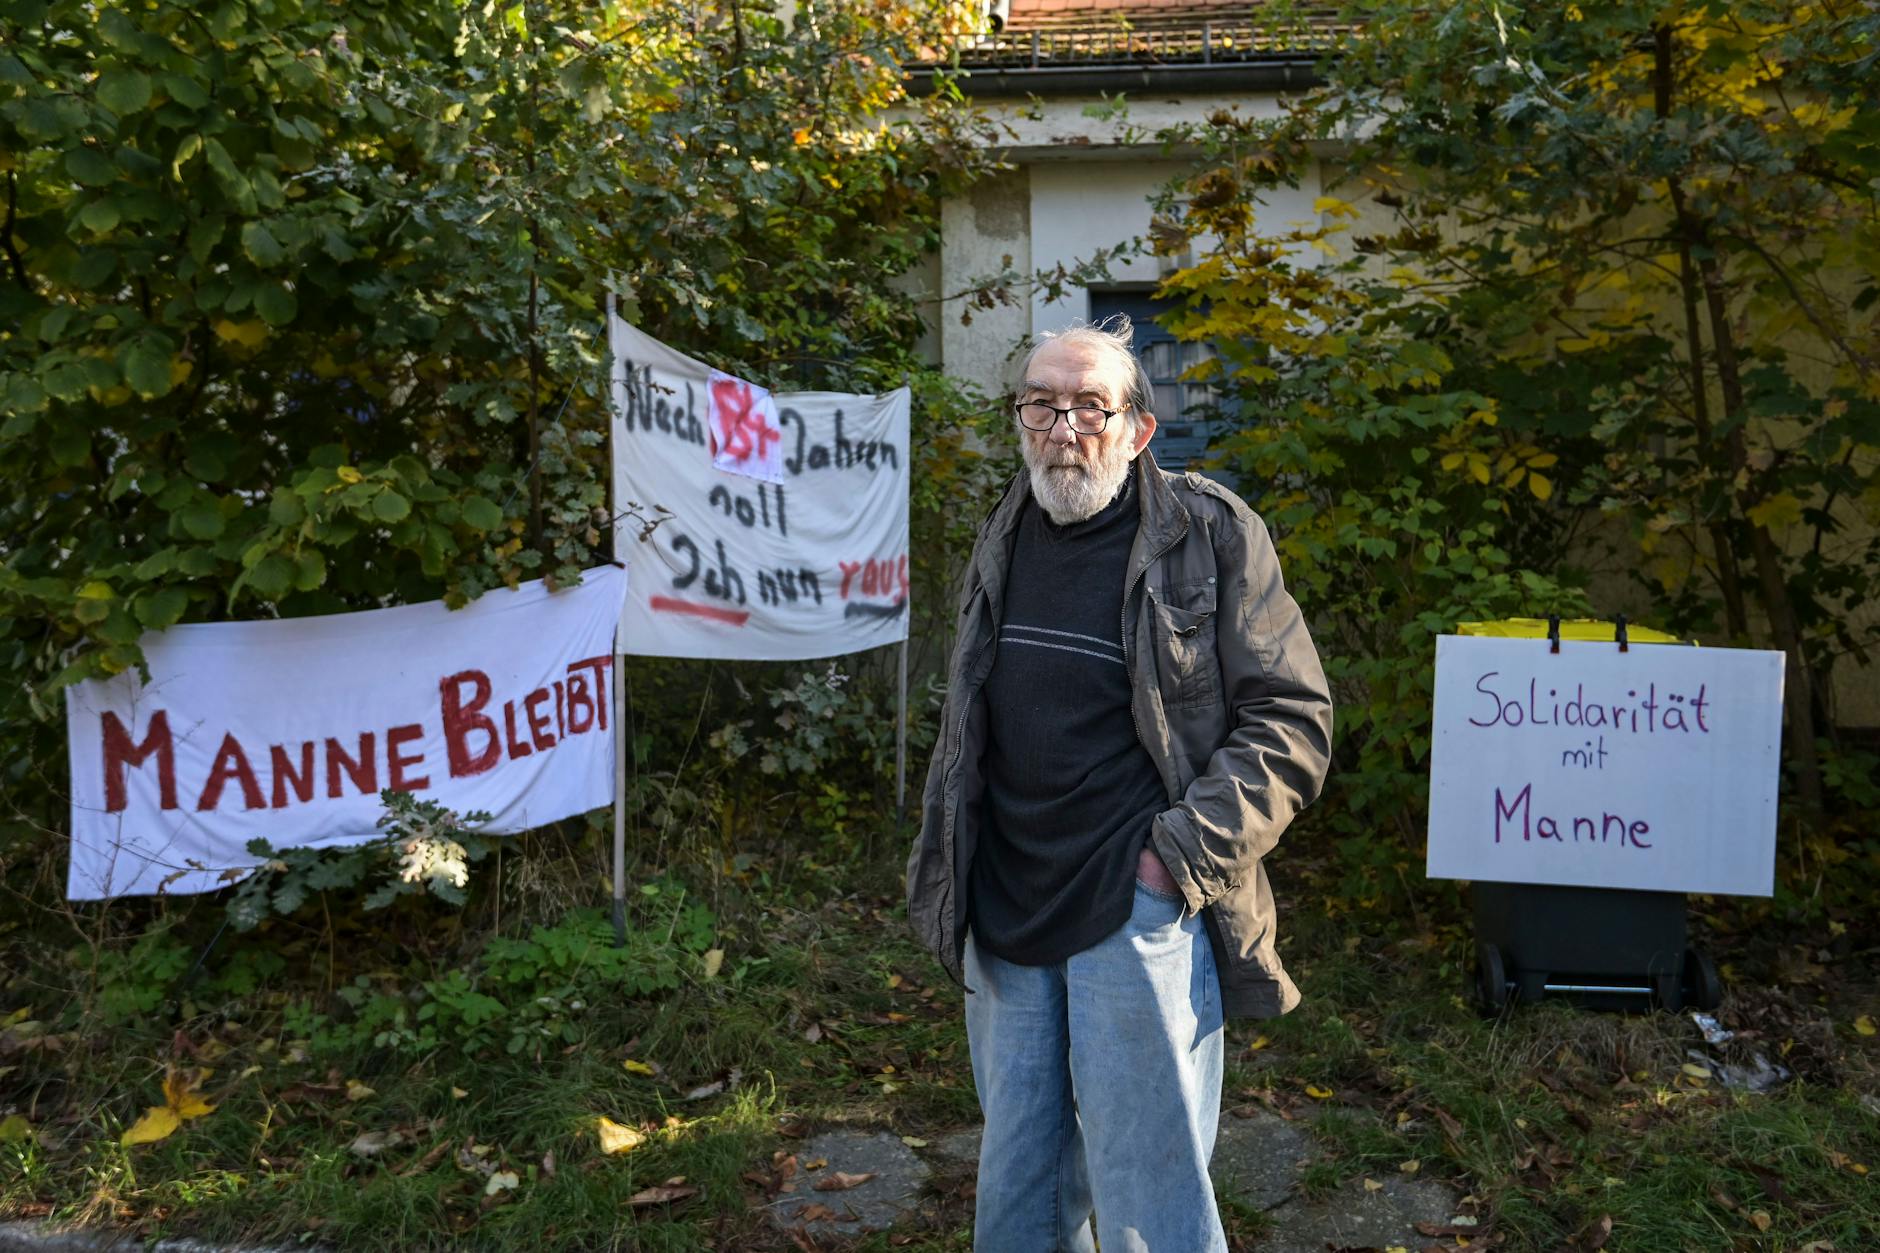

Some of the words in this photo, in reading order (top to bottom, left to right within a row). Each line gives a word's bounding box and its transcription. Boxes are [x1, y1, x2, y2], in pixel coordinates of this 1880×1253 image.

[624, 359, 705, 447] Nach
[780, 408, 898, 475] Jahren
[758, 568, 822, 606] nun
[101, 709, 430, 812] MANNE
[440, 655, 614, 778] BLEIBT
[1562, 736, 1608, 769] mit
[1495, 783, 1652, 849] Manne
